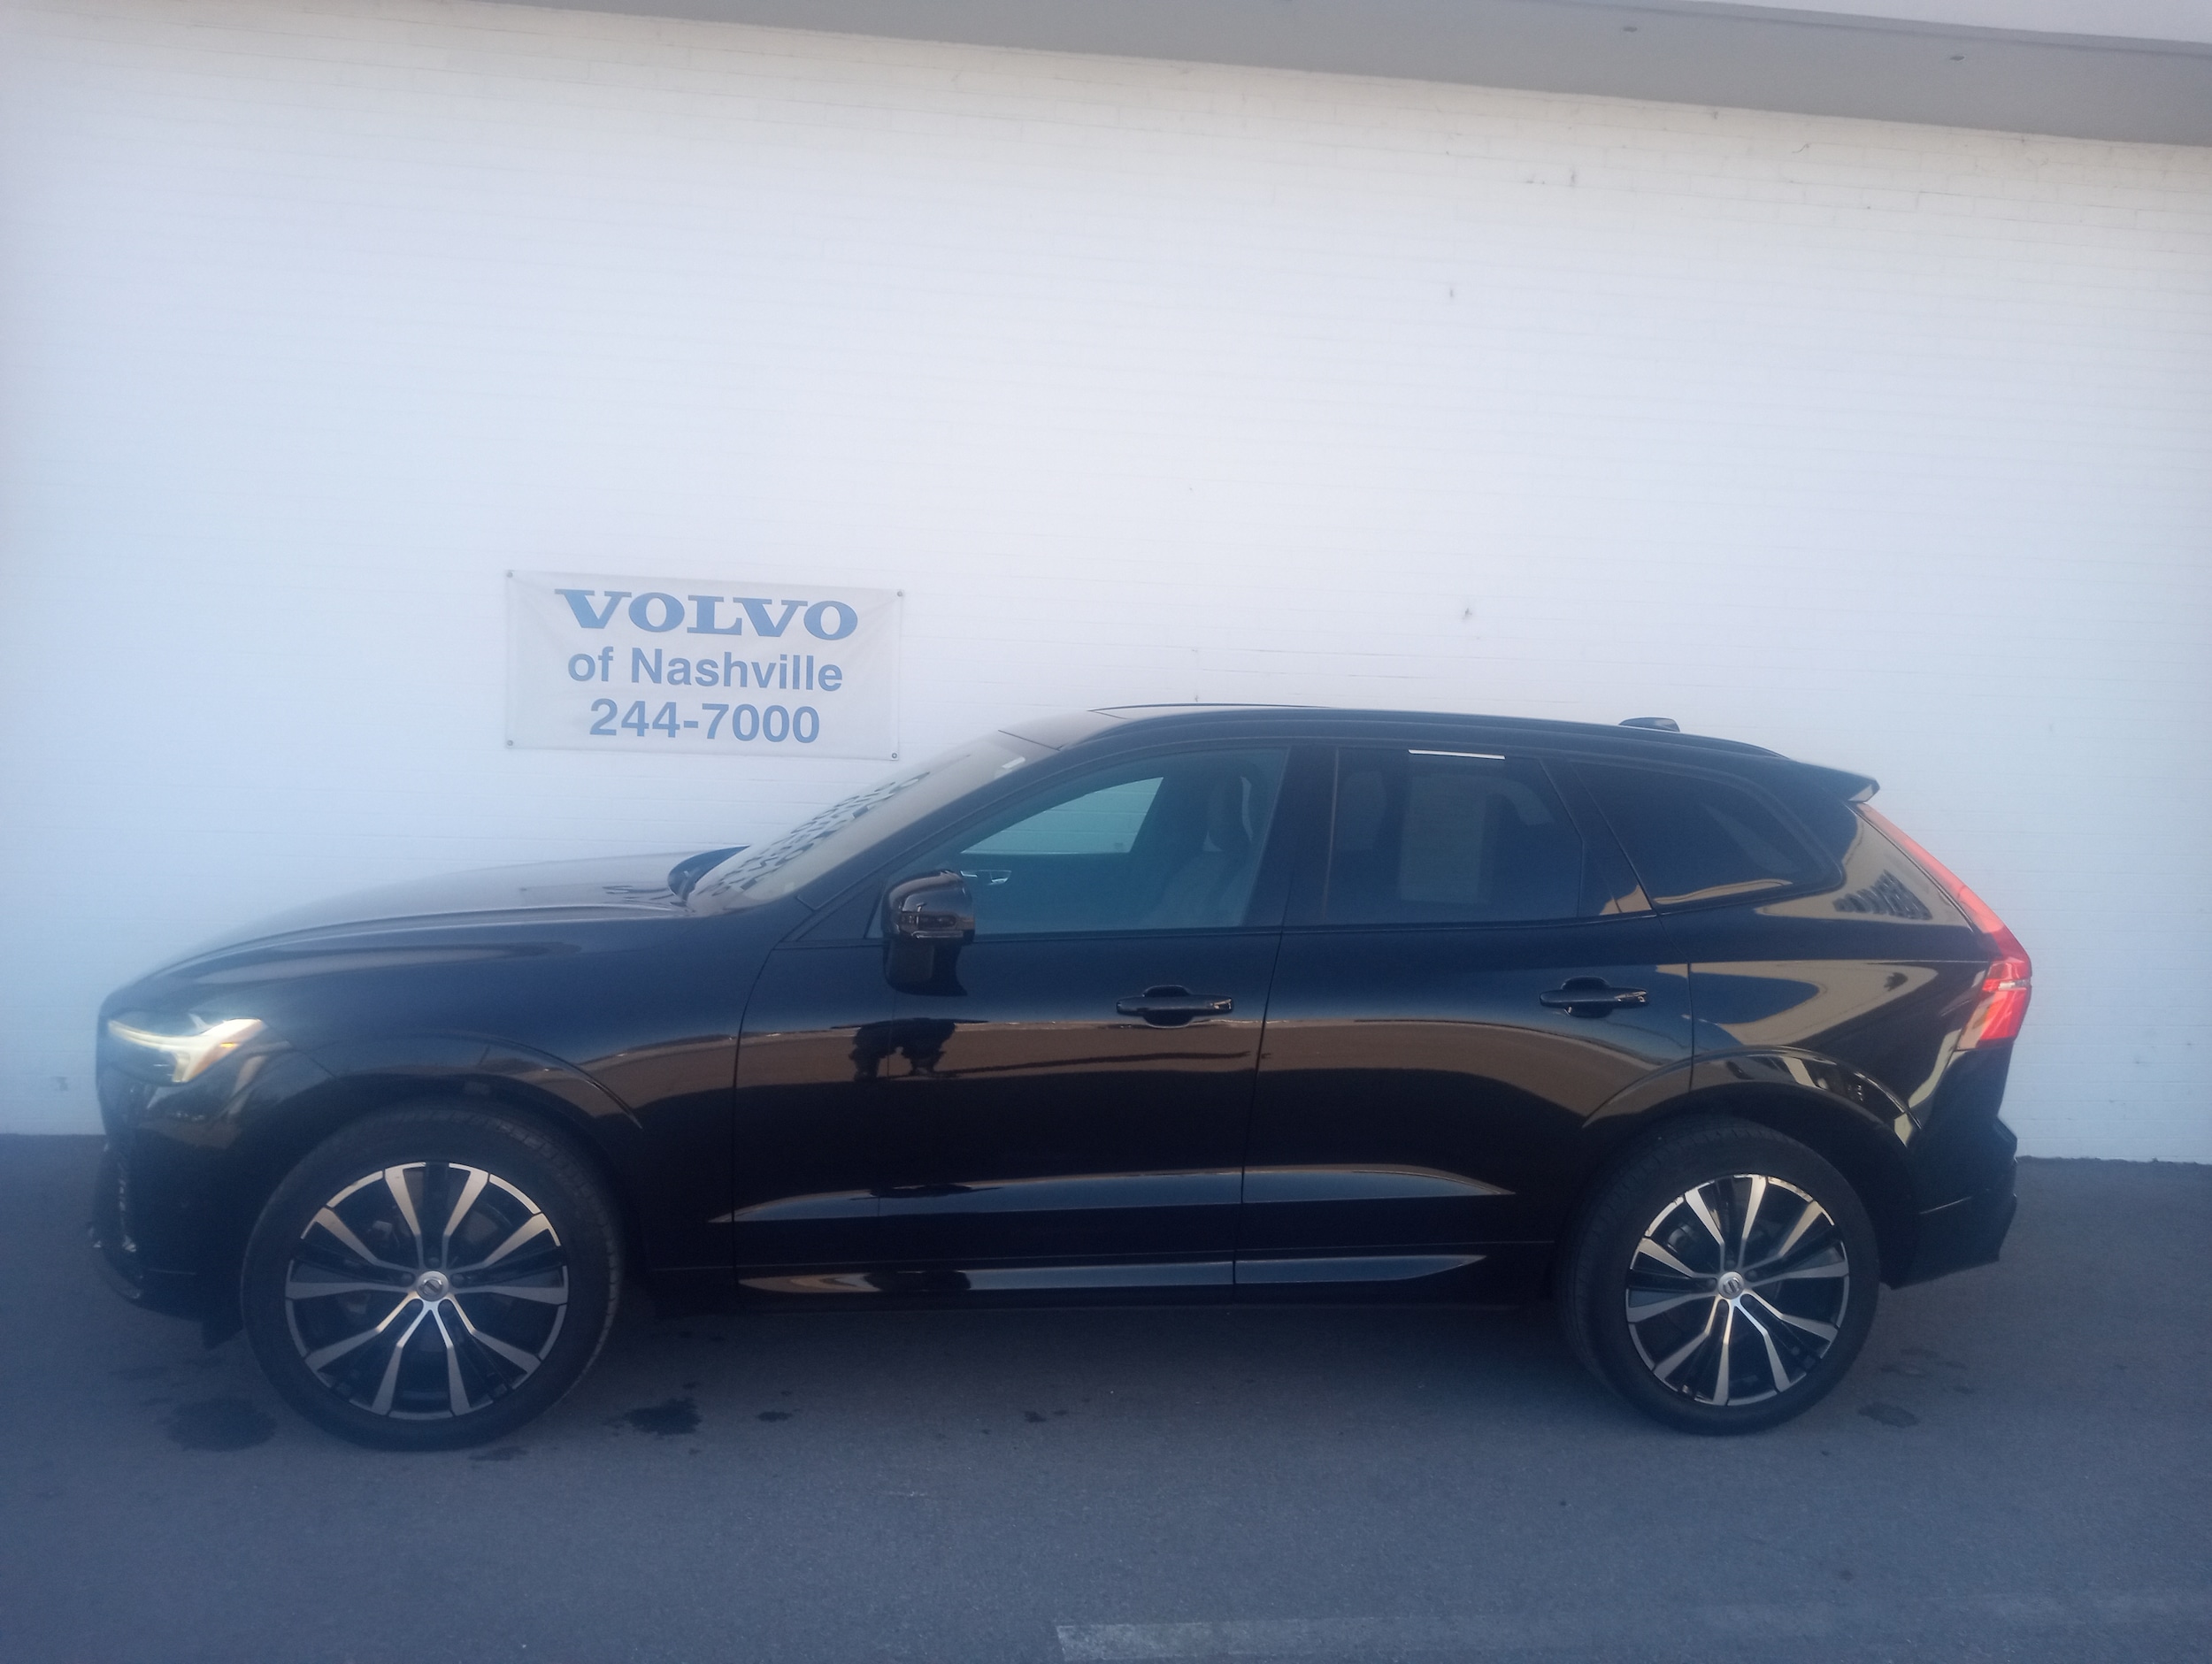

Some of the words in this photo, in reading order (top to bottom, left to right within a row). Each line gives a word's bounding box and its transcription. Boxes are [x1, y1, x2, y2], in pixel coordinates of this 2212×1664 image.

[554, 588, 858, 640] VOLVO
[567, 646, 614, 682] of
[631, 647, 843, 692] Nashville
[589, 698, 820, 743] 244-7000
